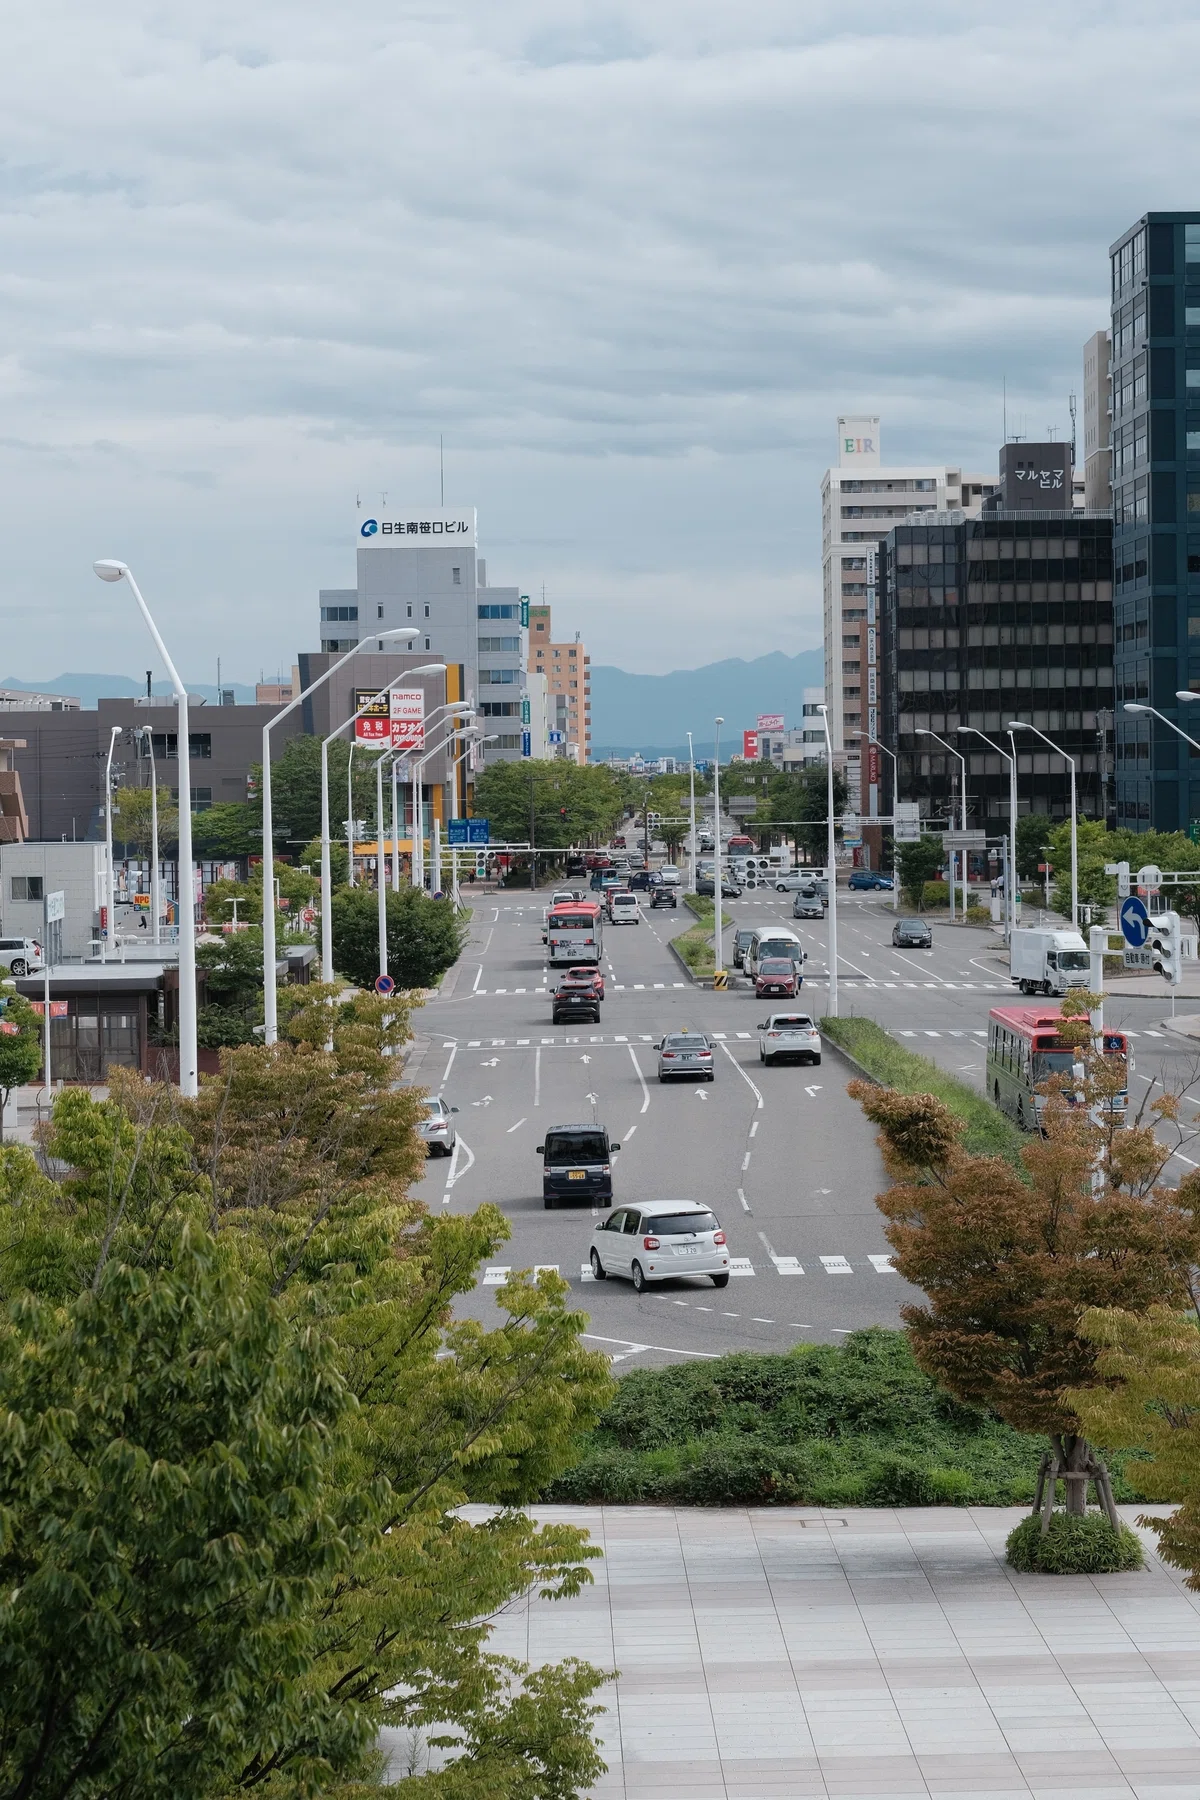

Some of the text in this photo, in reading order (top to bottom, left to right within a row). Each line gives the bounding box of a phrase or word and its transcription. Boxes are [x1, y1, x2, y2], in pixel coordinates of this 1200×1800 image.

[844, 438, 876, 453] EIR
[1014, 469, 1064, 481] マルヤマ
[1039, 479, 1063, 489] ビル
[382, 521, 469, 534] 日生南笹口ビル
[392, 693, 422, 701] namco
[392, 722, 424, 733] カラオケ
[134, 895, 150, 904] NPC
